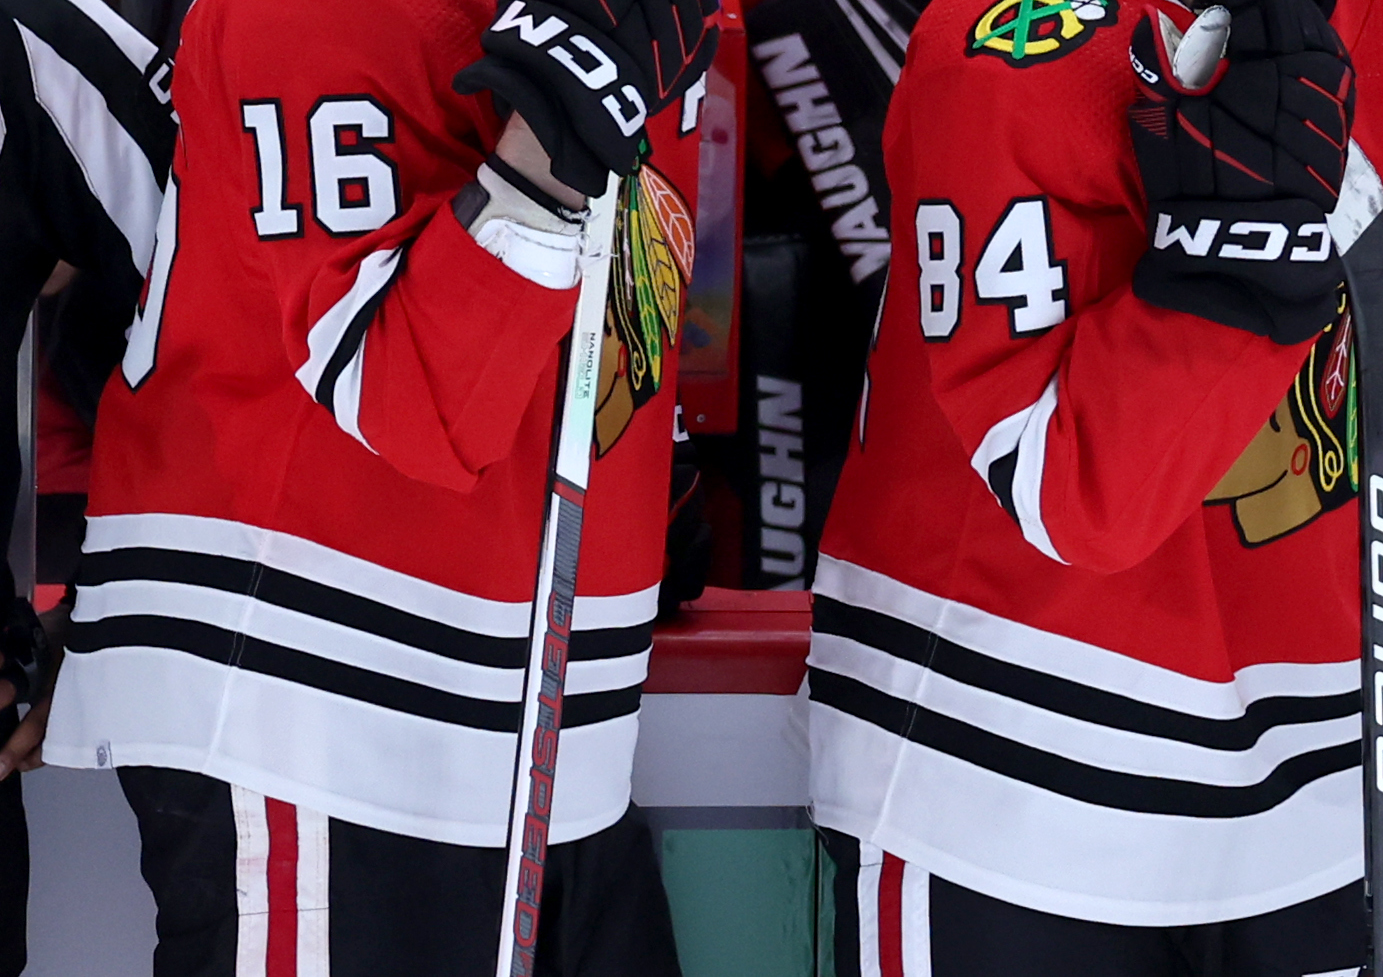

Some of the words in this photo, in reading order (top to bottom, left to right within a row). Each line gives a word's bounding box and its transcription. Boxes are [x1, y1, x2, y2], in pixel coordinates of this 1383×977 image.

[489, 0, 648, 138] CCM
[241, 97, 401, 240] 16
[752, 31, 892, 286] VAUGHN
[915, 198, 1067, 340] 84
[1153, 212, 1333, 262] CCM
[583, 332, 597, 399] NANOLITE
[512, 589, 571, 949] JETSPEED
